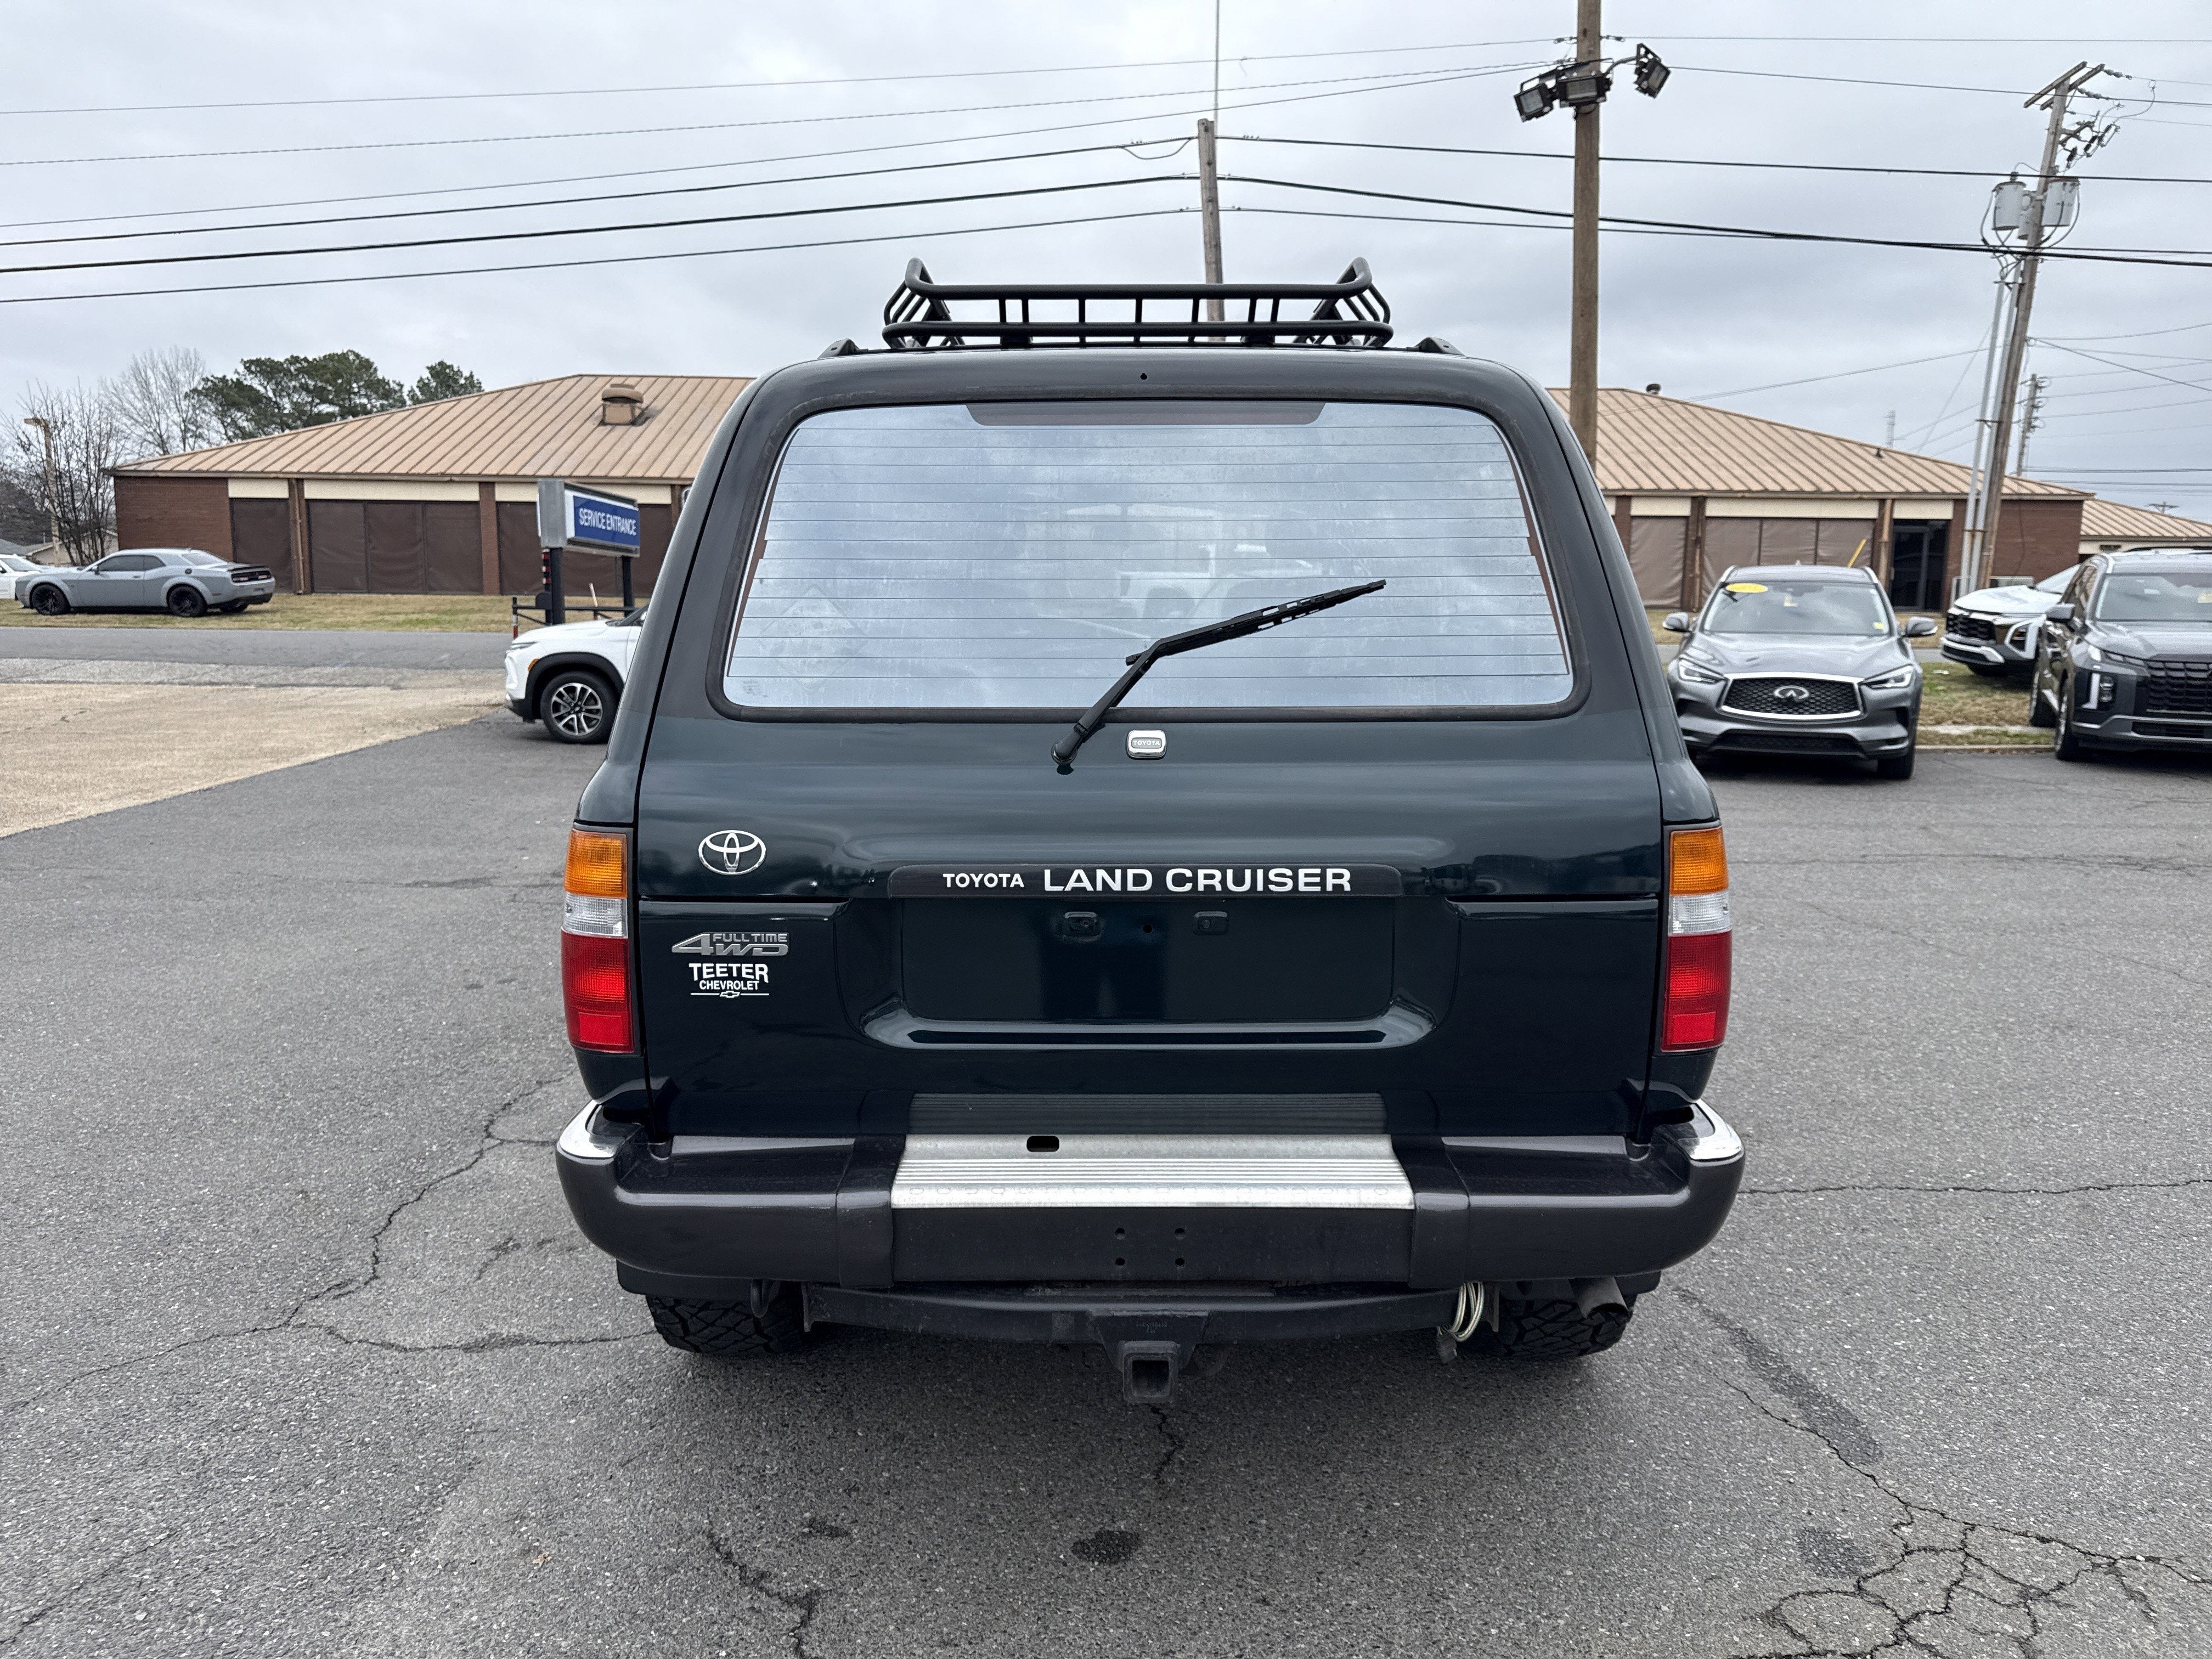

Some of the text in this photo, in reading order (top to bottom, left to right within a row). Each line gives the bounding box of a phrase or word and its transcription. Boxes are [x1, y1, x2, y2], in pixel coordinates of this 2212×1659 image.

[579, 507, 636, 536] SERVICE ENTRANCE
[943, 868, 1351, 892] TOYOTA LAND CRUISER
[672, 933, 789, 956] 4WD
[713, 933, 750, 943] FULL
[689, 963, 769, 983] TEETER
[699, 980, 759, 990] CHEVROLET
